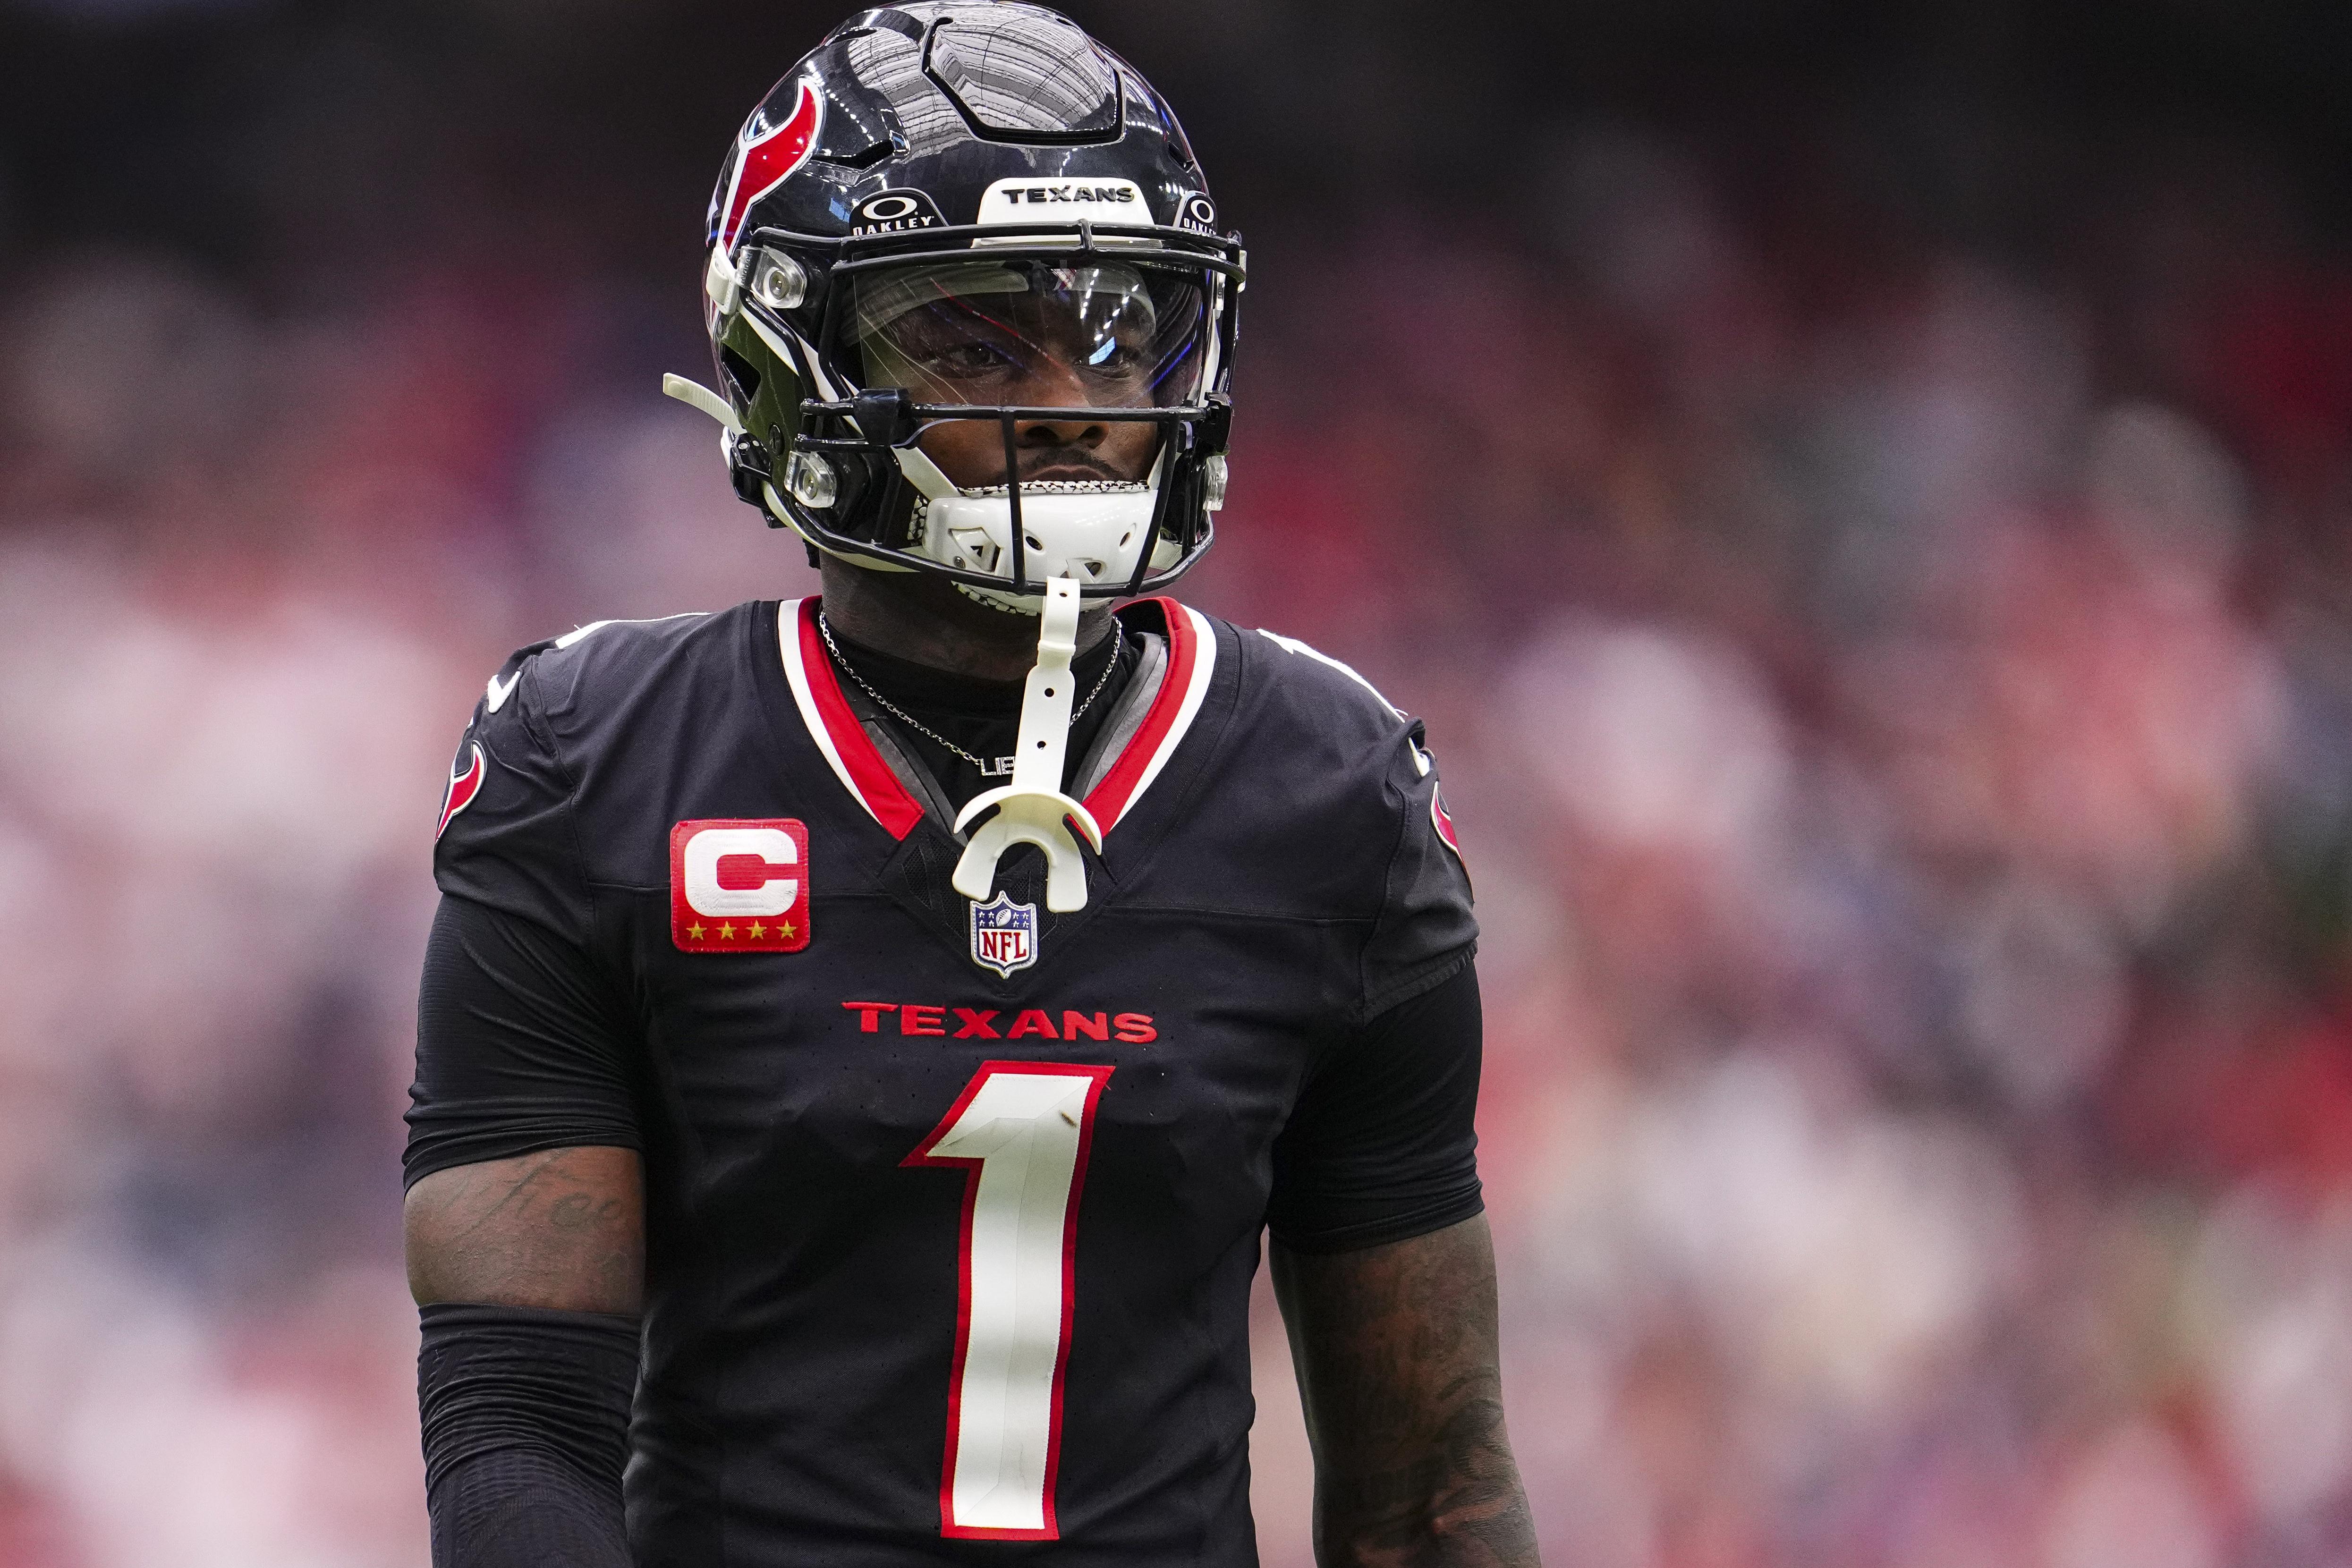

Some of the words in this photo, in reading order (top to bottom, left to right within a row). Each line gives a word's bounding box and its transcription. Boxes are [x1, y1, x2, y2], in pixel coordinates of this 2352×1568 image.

[1001, 185, 1135, 203] TEXANS
[853, 216, 931, 236] OAKLEY
[684, 829, 798, 917] C
[982, 932, 1026, 962] NFL
[841, 1001, 1157, 1043] TEXANS
[898, 1059, 1116, 1541] 1
